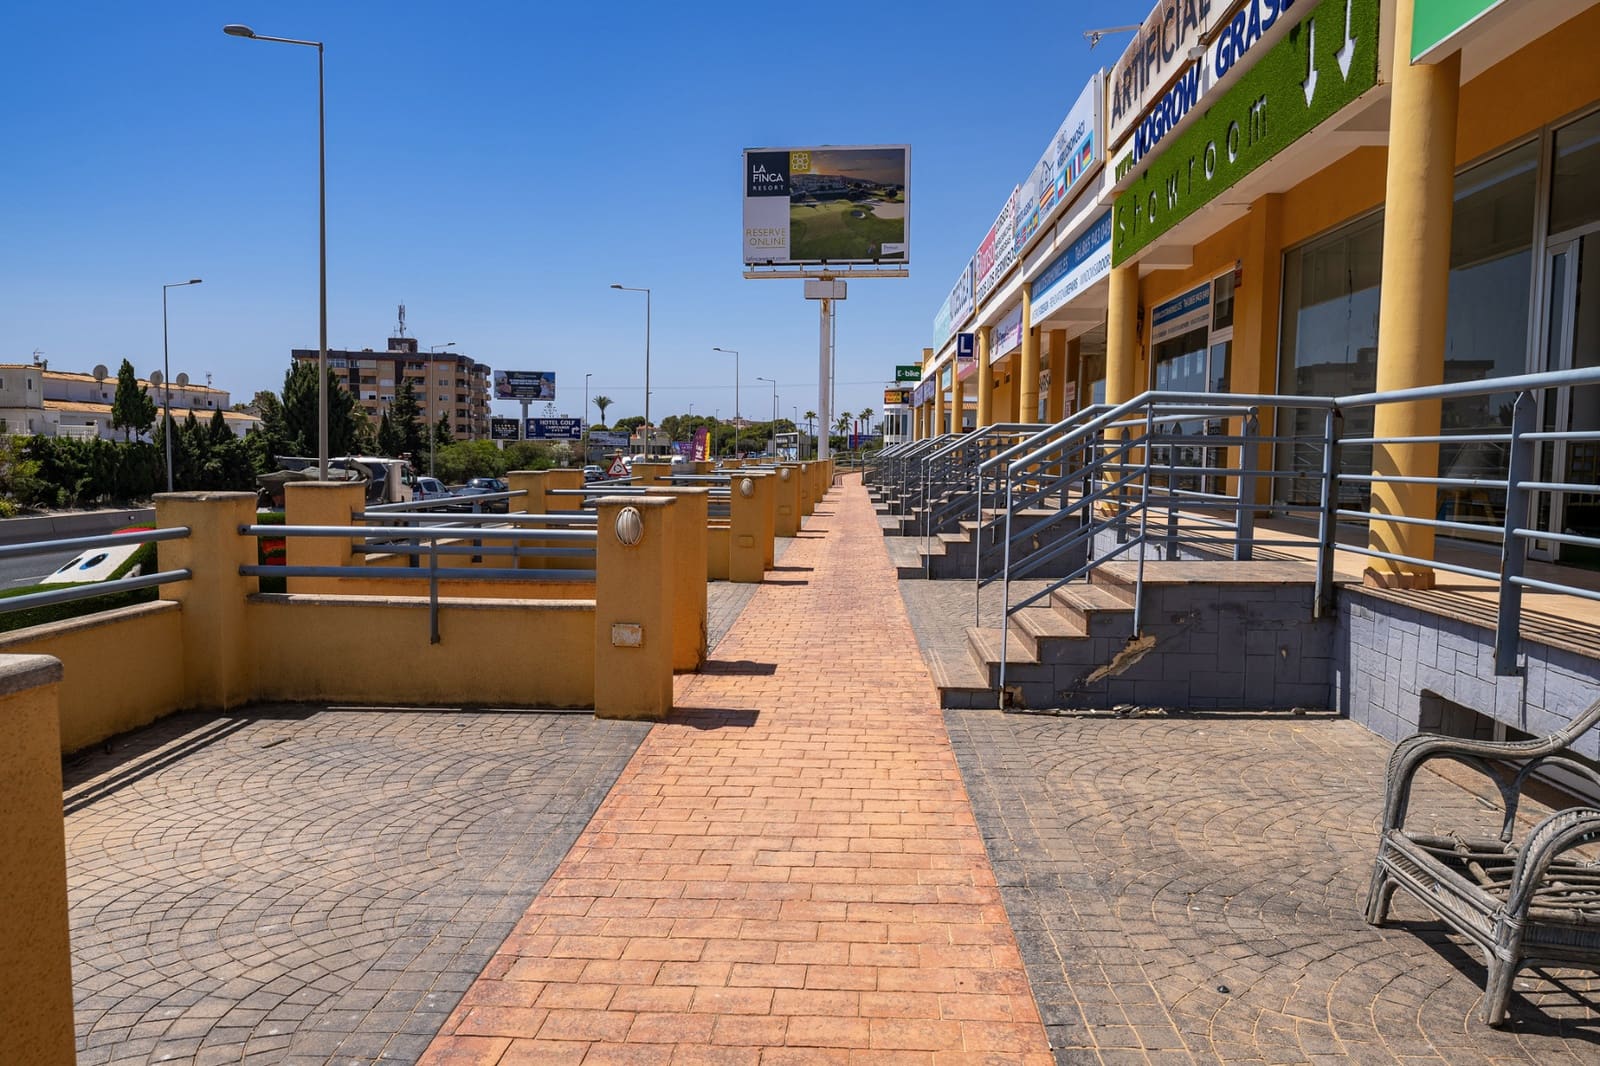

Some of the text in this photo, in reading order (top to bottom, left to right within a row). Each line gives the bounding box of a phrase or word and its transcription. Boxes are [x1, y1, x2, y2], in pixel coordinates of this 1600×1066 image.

[752, 164, 766, 174] LA
[752, 173, 784, 183] FINCA
[746, 227, 786, 237] RESERVE
[750, 236, 786, 246] ONLINE
[961, 336, 972, 353] L
